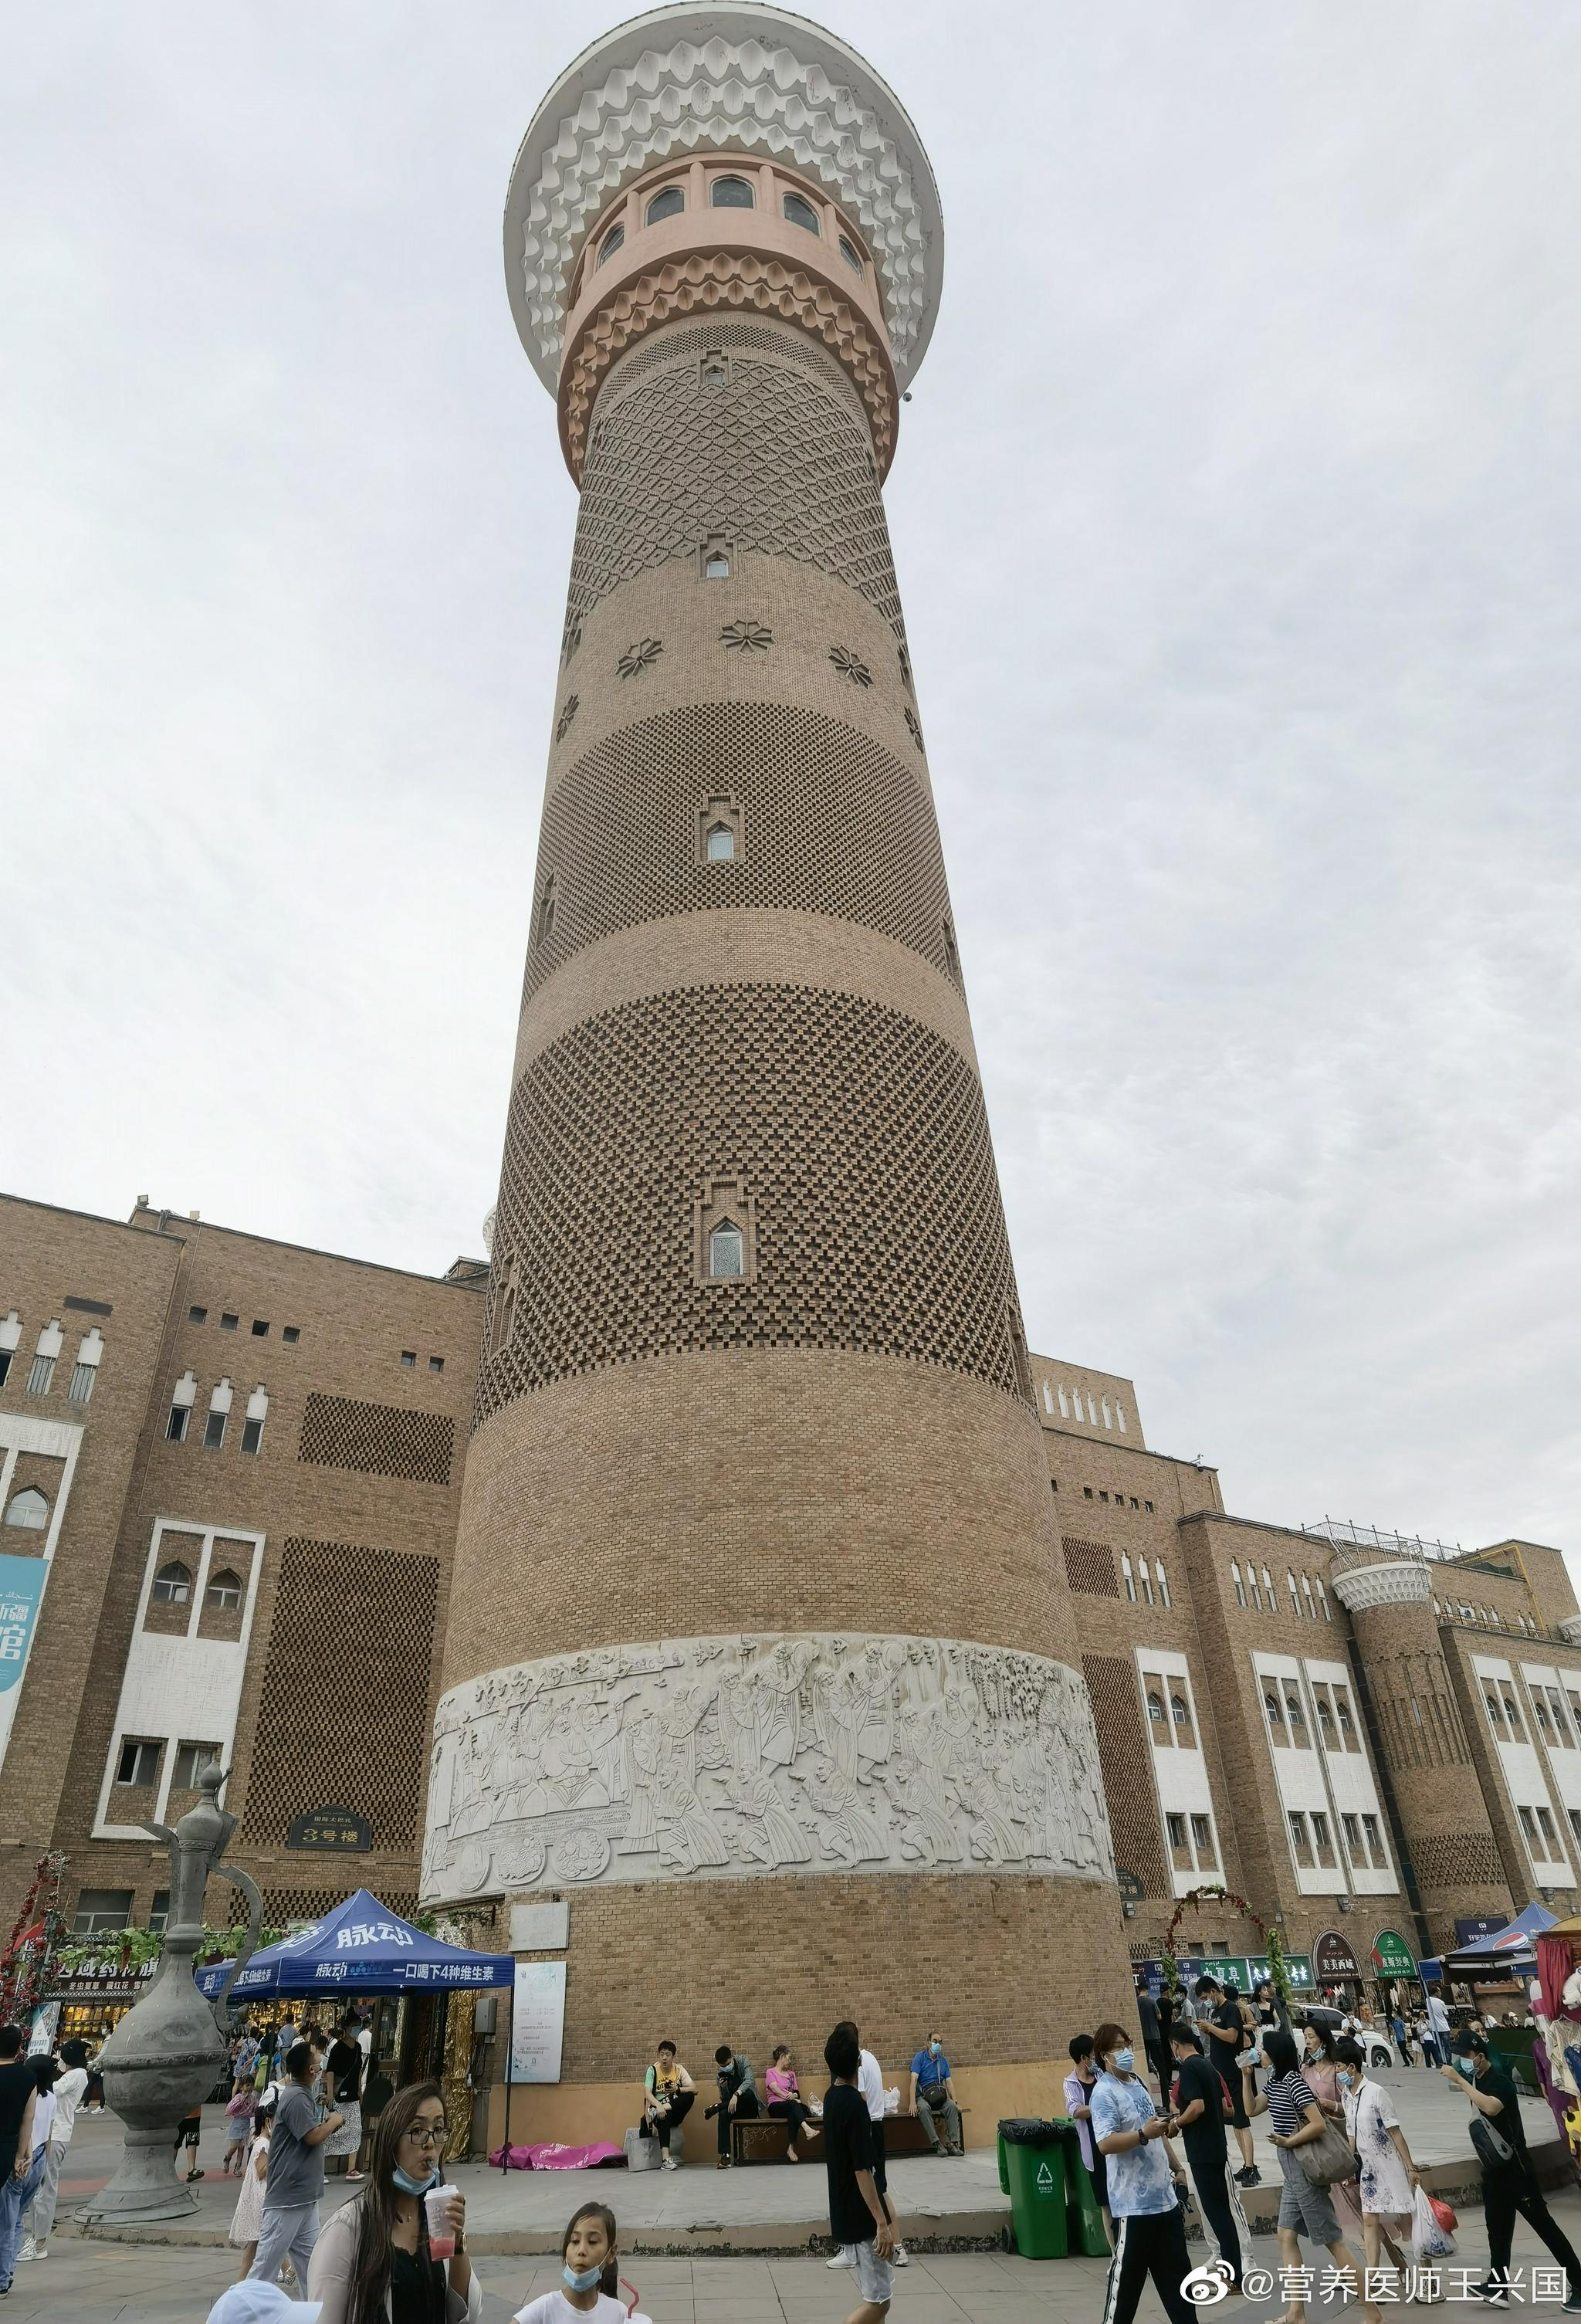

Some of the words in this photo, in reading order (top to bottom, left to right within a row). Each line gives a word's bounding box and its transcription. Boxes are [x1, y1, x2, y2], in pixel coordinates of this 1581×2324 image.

[302, 1828, 358, 1843] 3号楼
[336, 1922, 415, 1950] 脉动
[315, 1962, 348, 1981] 脉动
[392, 1963, 494, 1981] 一口喝下4种维生素
[69, 1981, 100, 1990] 冬虫夏草
